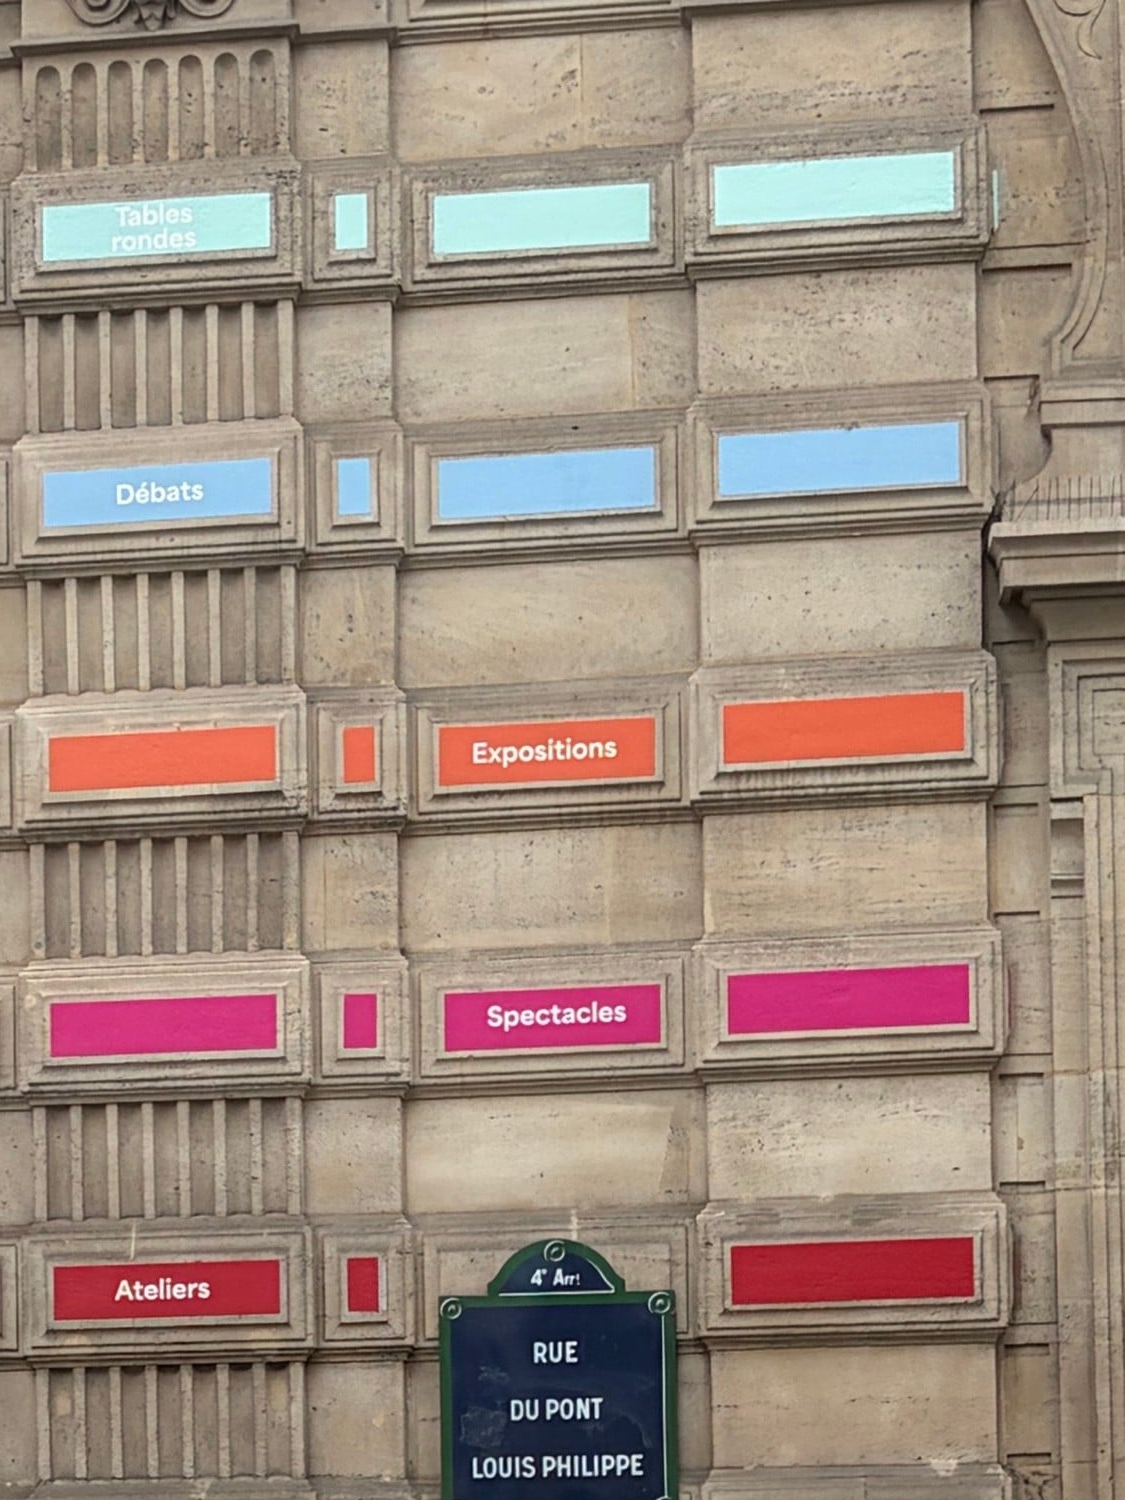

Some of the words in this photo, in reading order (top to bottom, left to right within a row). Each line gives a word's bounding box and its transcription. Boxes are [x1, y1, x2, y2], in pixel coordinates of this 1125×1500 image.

[115, 204, 193, 227] Tables
[112, 228, 197, 252] rondes
[116, 481, 204, 505] Débats
[472, 737, 617, 768] Expositions
[487, 1000, 627, 1032] Spectacles
[114, 1277, 211, 1302] Ateliers
[533, 1341, 579, 1364] RUE
[510, 1399, 540, 1421] DU
[546, 1397, 604, 1421] PONT
[472, 1456, 536, 1480] LOUIS
[542, 1453, 645, 1478] PHILIPPE
